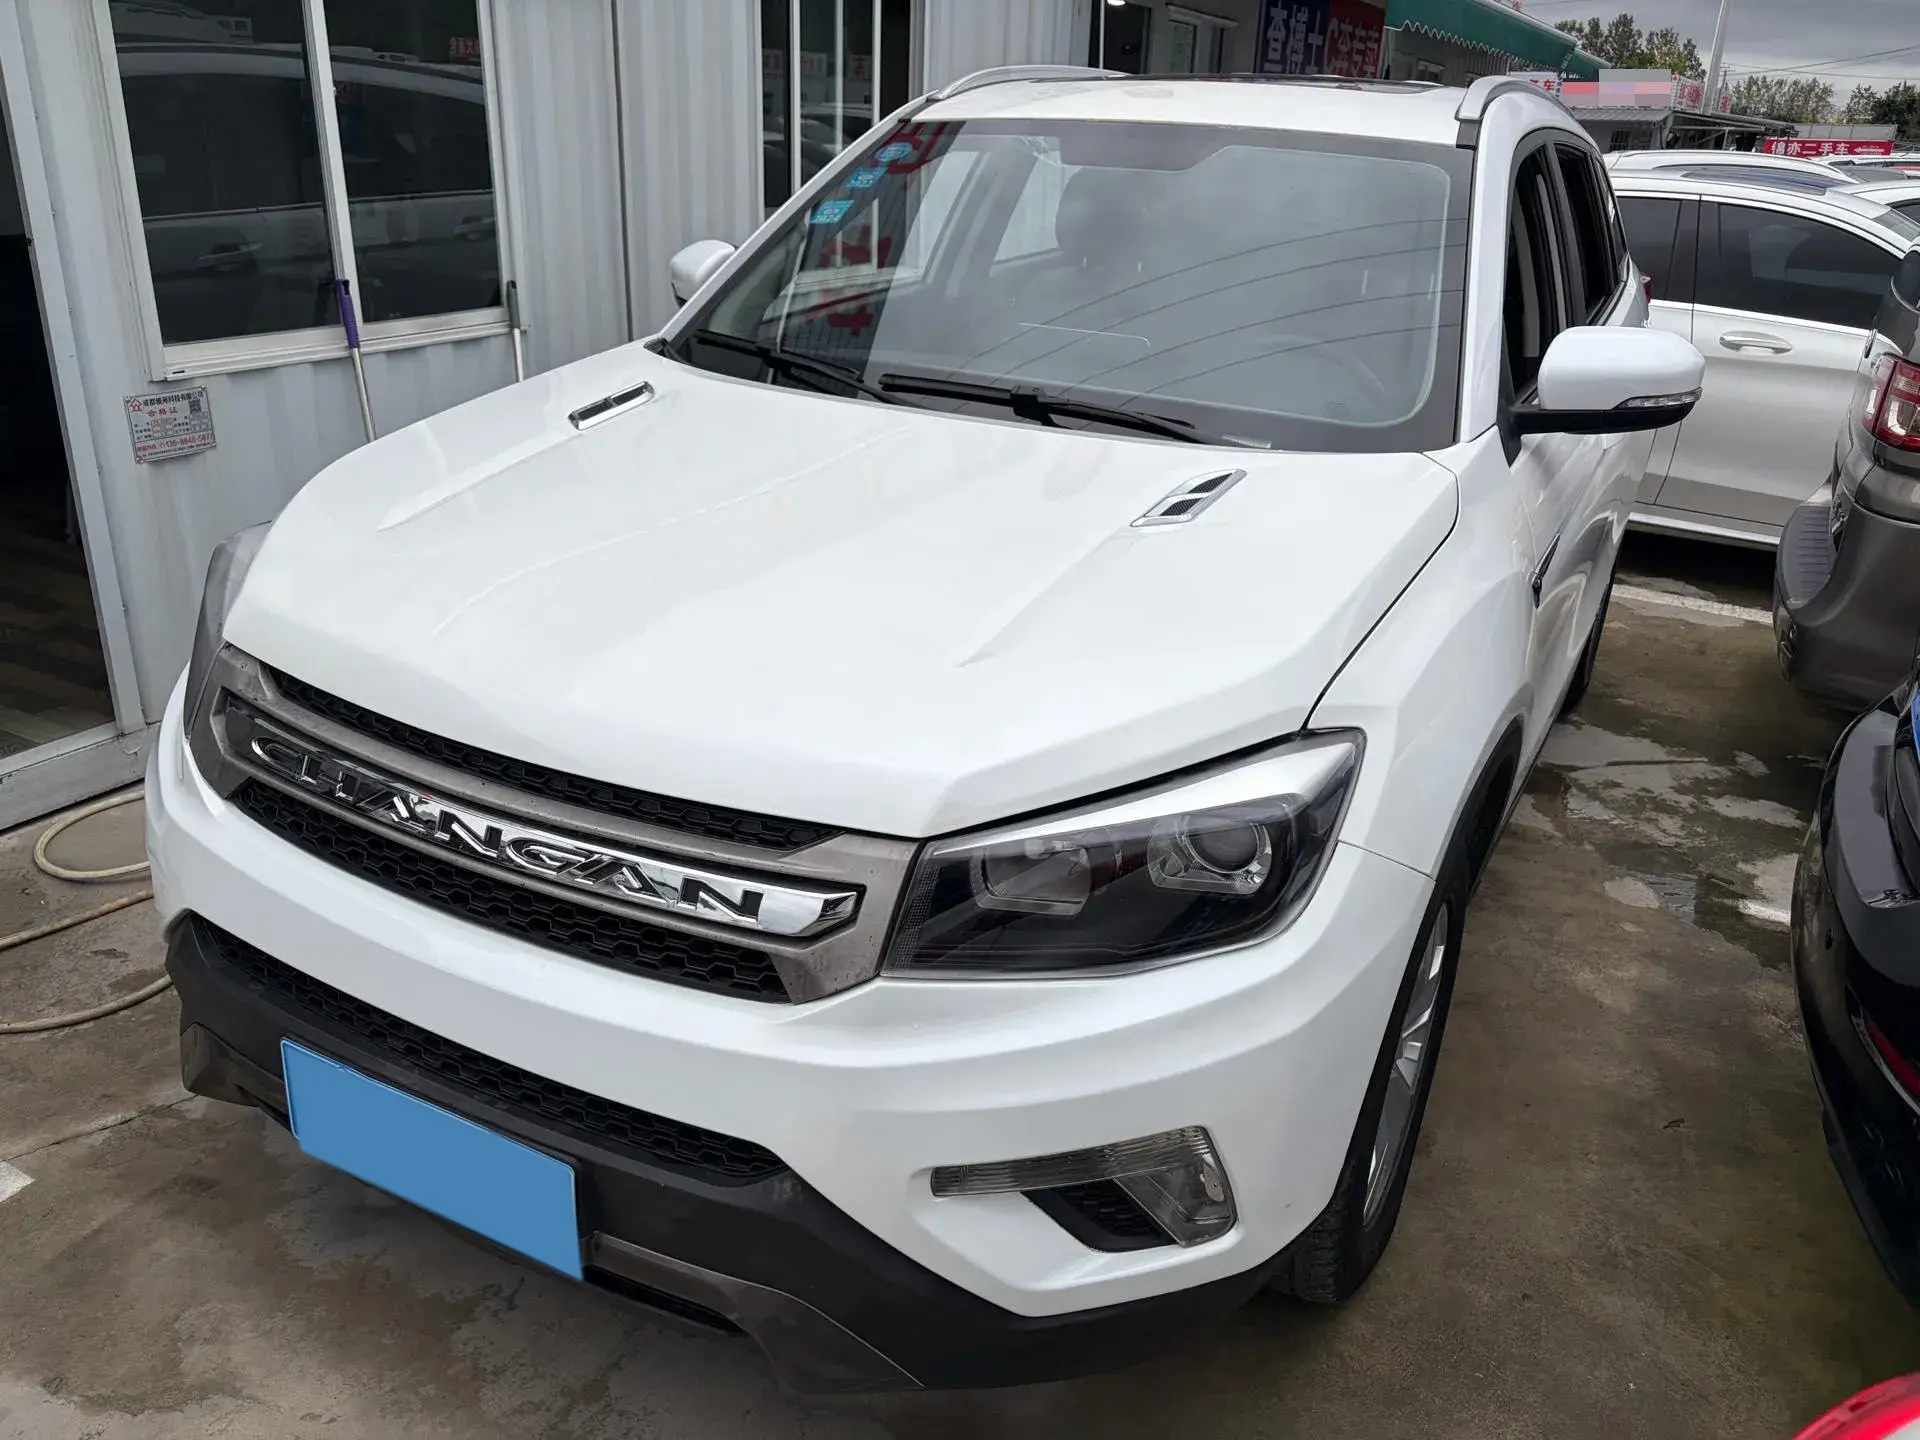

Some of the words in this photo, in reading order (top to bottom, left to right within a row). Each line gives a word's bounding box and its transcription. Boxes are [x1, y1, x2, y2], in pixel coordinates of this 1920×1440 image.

[1262, 0, 1324, 74] 查博士
[251, 736, 764, 924] CHANGAN
